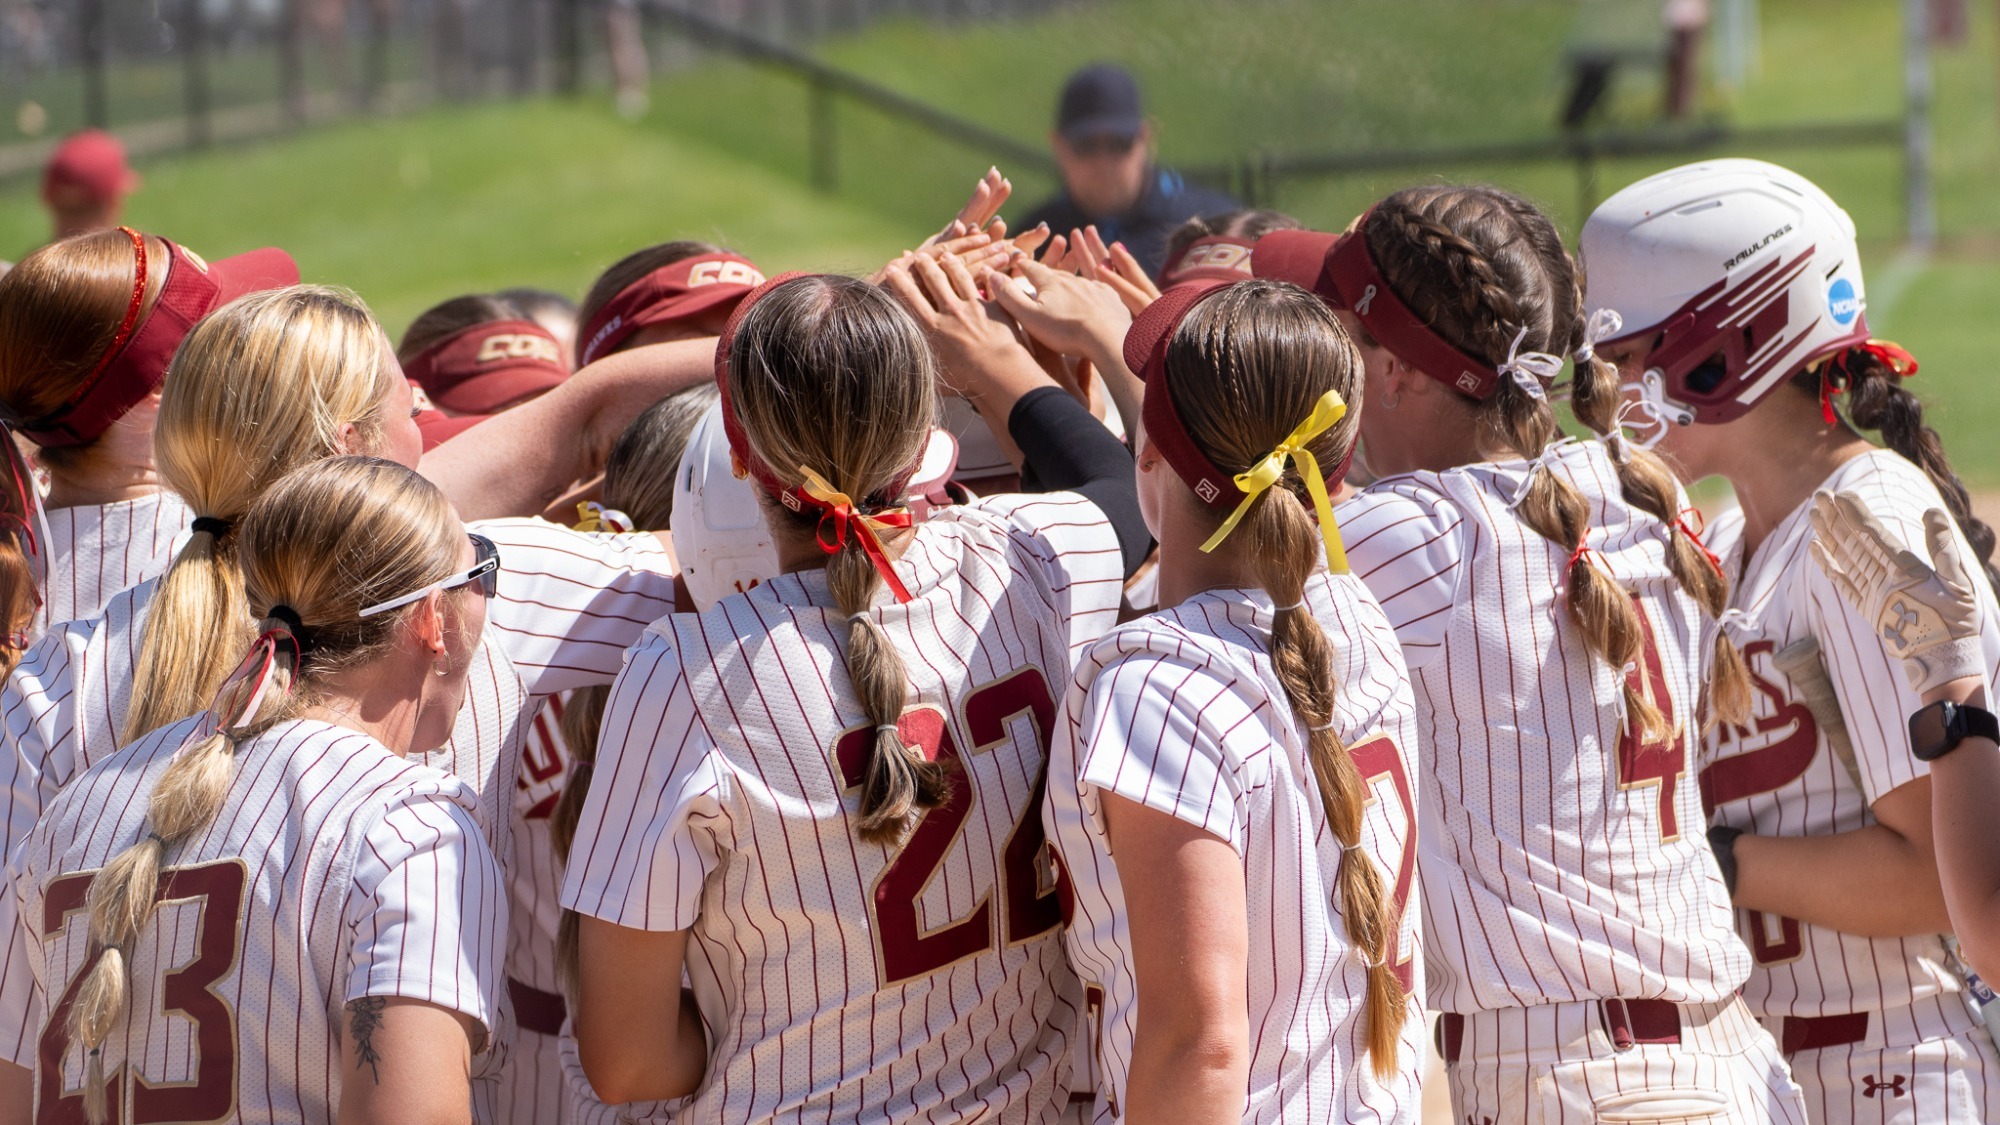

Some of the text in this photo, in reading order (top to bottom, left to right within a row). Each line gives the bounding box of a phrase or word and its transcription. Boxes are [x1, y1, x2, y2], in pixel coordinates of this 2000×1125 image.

[1723, 223, 1793, 271] RAWLINGS
[830, 663, 1062, 990] 22
[1613, 588, 1688, 845] 4
[34, 858, 249, 1125] 23
